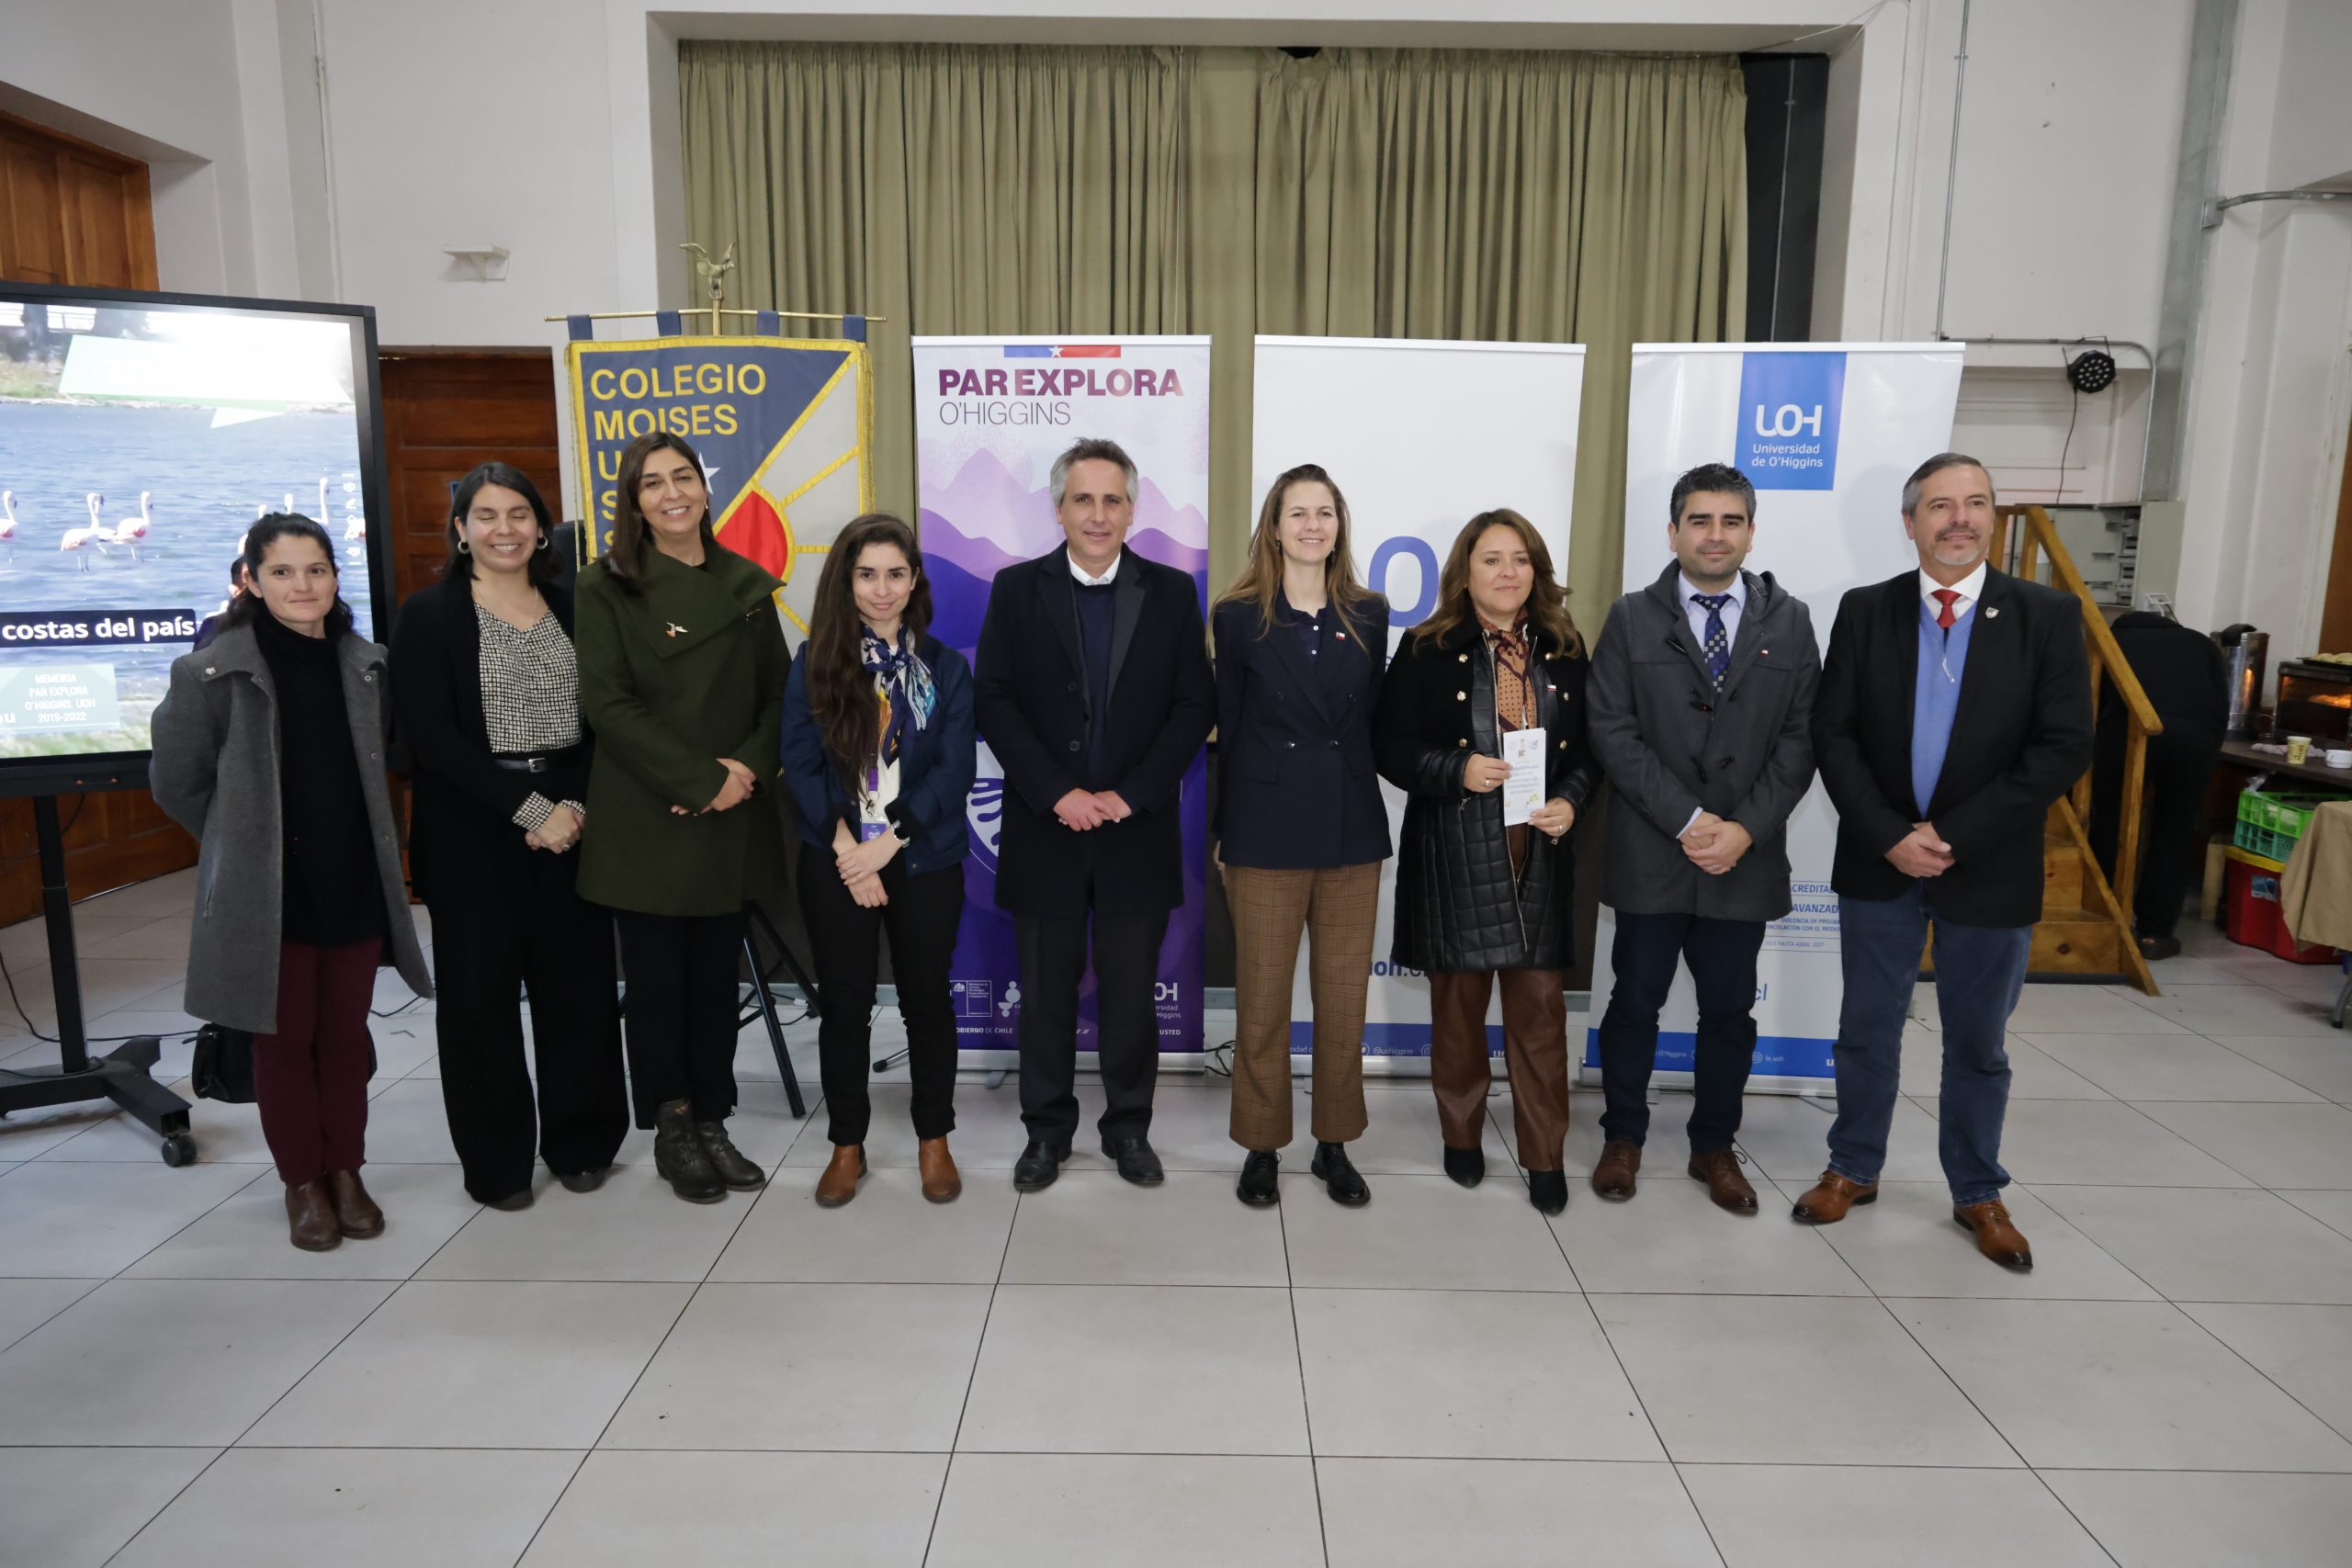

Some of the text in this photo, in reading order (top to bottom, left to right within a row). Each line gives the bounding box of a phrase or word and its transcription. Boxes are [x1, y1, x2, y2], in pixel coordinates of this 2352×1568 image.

[591, 363, 766, 400] COLEGIO
[938, 368, 1184, 397] PAR EXPLORA
[939, 400, 1071, 425] O'HIGGINS
[594, 403, 739, 441] MOISES
[1756, 404, 1823, 437] UOH
[1753, 444, 1820, 455] Universidad
[1752, 457, 1824, 469] de O'Higgins
[2, 615, 196, 642] costas del país
[34, 673, 77, 684] MEMORIA
[28, 685, 89, 697] PAR EXPLORA
[24, 698, 96, 711] O'HIGGINS UOH
[37, 711, 87, 723] 2019-2022
[1792, 884, 1835, 894] CREDITA
[1792, 903, 1839, 913] AVANZAD
